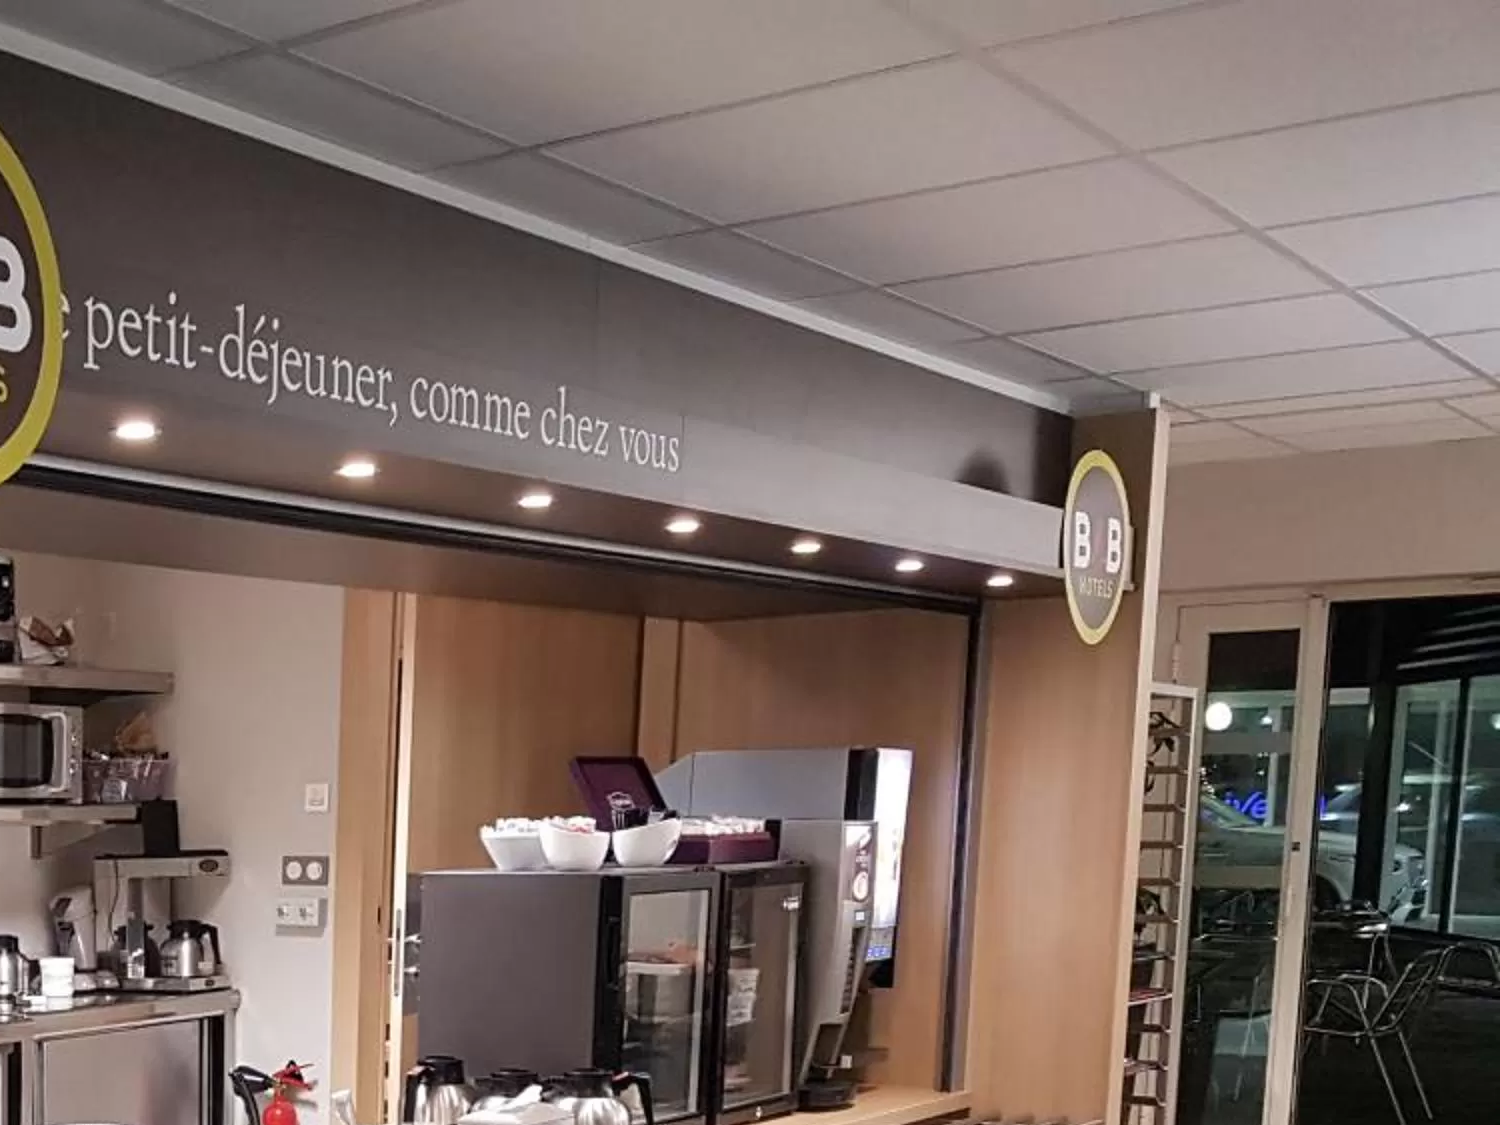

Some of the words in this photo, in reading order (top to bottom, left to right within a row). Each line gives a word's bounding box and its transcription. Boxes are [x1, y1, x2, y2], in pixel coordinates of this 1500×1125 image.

[83, 290, 398, 427] petit-déjeuner,
[409, 376, 531, 440] comme
[540, 385, 609, 457] chez
[618, 423, 680, 473] vous
